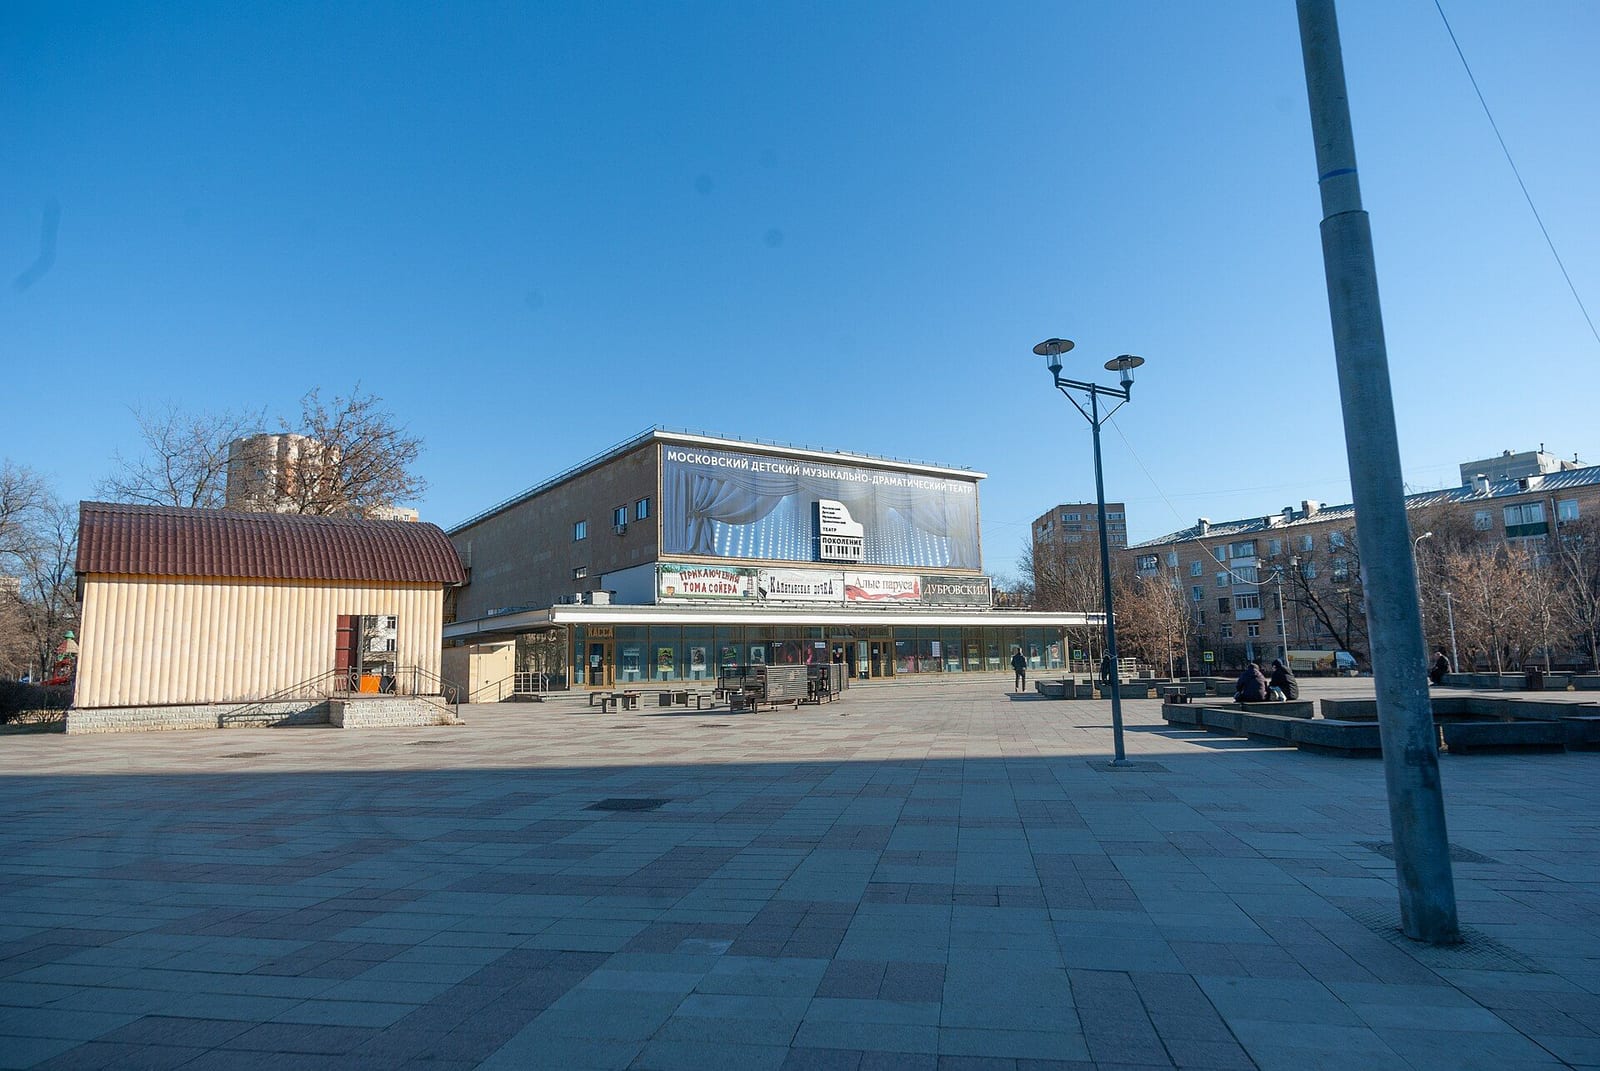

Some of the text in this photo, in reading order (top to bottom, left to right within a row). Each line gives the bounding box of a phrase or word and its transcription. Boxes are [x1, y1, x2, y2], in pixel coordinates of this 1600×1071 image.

[667, 450, 749, 469] МОСКОВСКИЙ
[751, 461, 800, 476] ДЕТСКИЙ
[949, 483, 974, 494] ТЕАТР
[822, 537, 862, 546] ПОКОЛЕНИЕ
[680, 568, 740, 584] ПРИКЛЮЧЕНИЯ
[683, 581, 738, 594] ТОМА СОЙЕРА
[855, 577, 913, 592] Алые паруса
[924, 583, 987, 595] ДУБРОВСКИЙ
[588, 627, 613, 638] КАССА
